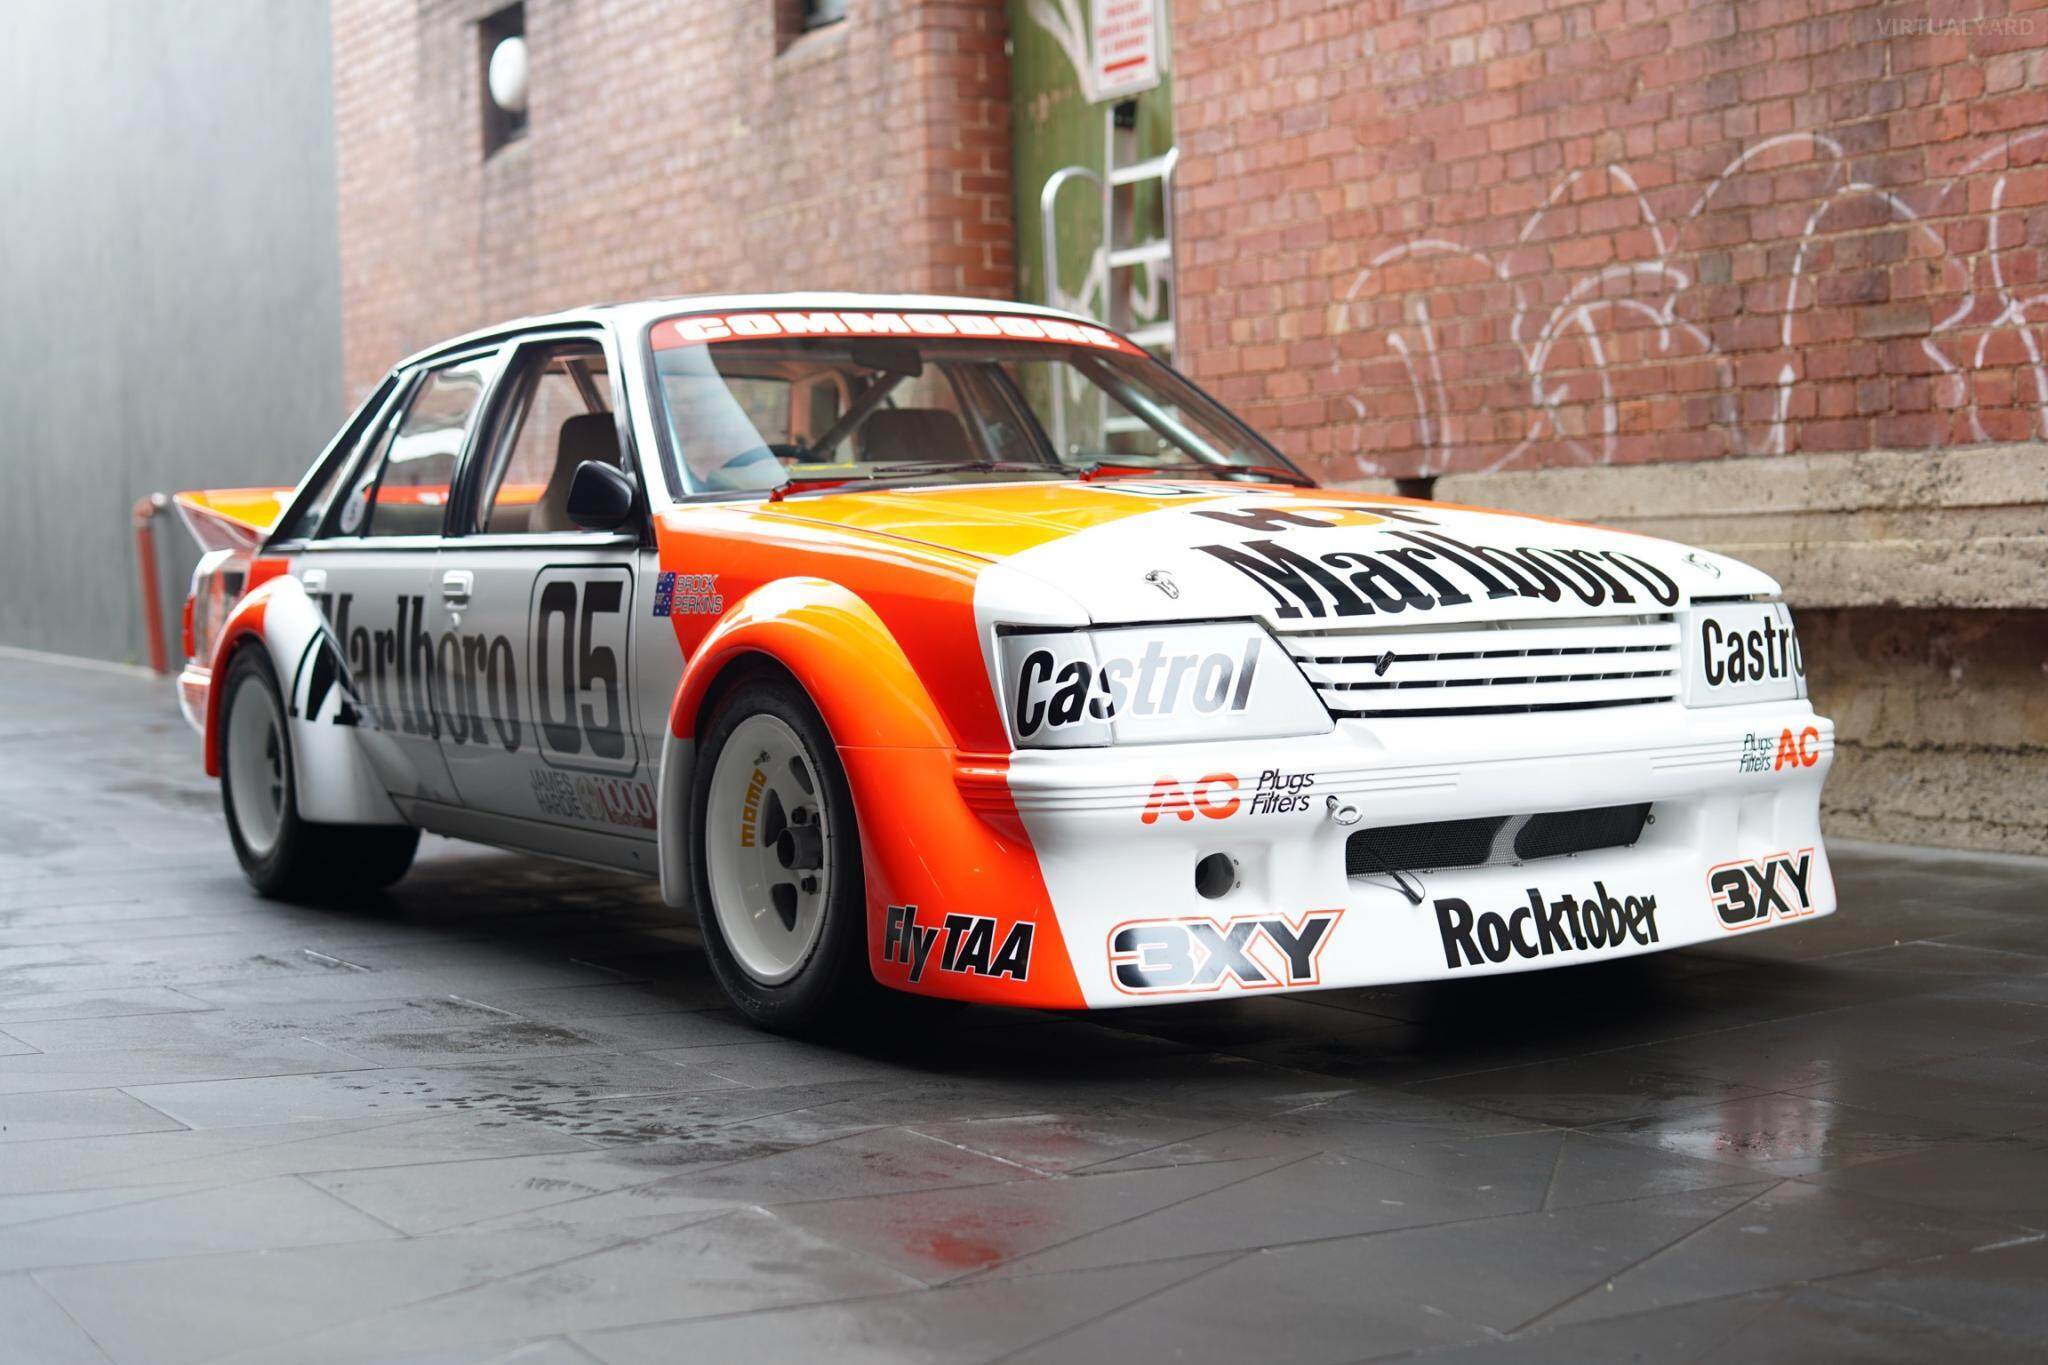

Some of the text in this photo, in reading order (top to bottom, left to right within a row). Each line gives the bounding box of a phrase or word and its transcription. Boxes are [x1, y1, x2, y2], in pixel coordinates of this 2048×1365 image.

[673, 311, 1121, 350] COMMODORE
[676, 574, 719, 594] BROCK
[1190, 530, 1680, 619] Marlboro
[673, 595, 723, 615] PERKINS
[290, 591, 520, 753] Marlboro
[537, 580, 626, 760] 05
[1016, 637, 1263, 738] Castrol
[1739, 753, 1771, 773] Filters
[1743, 732, 1774, 756] Plugs
[1775, 726, 1819, 771] AC
[1141, 772, 1241, 825] AC
[1250, 791, 1310, 815] Filters
[1256, 768, 1315, 794] Plugs
[1709, 852, 1812, 927] 3XY
[884, 905, 1036, 983] Fly TAA
[1432, 880, 1661, 970] Rocktober
[1110, 913, 1338, 991] 3XY
